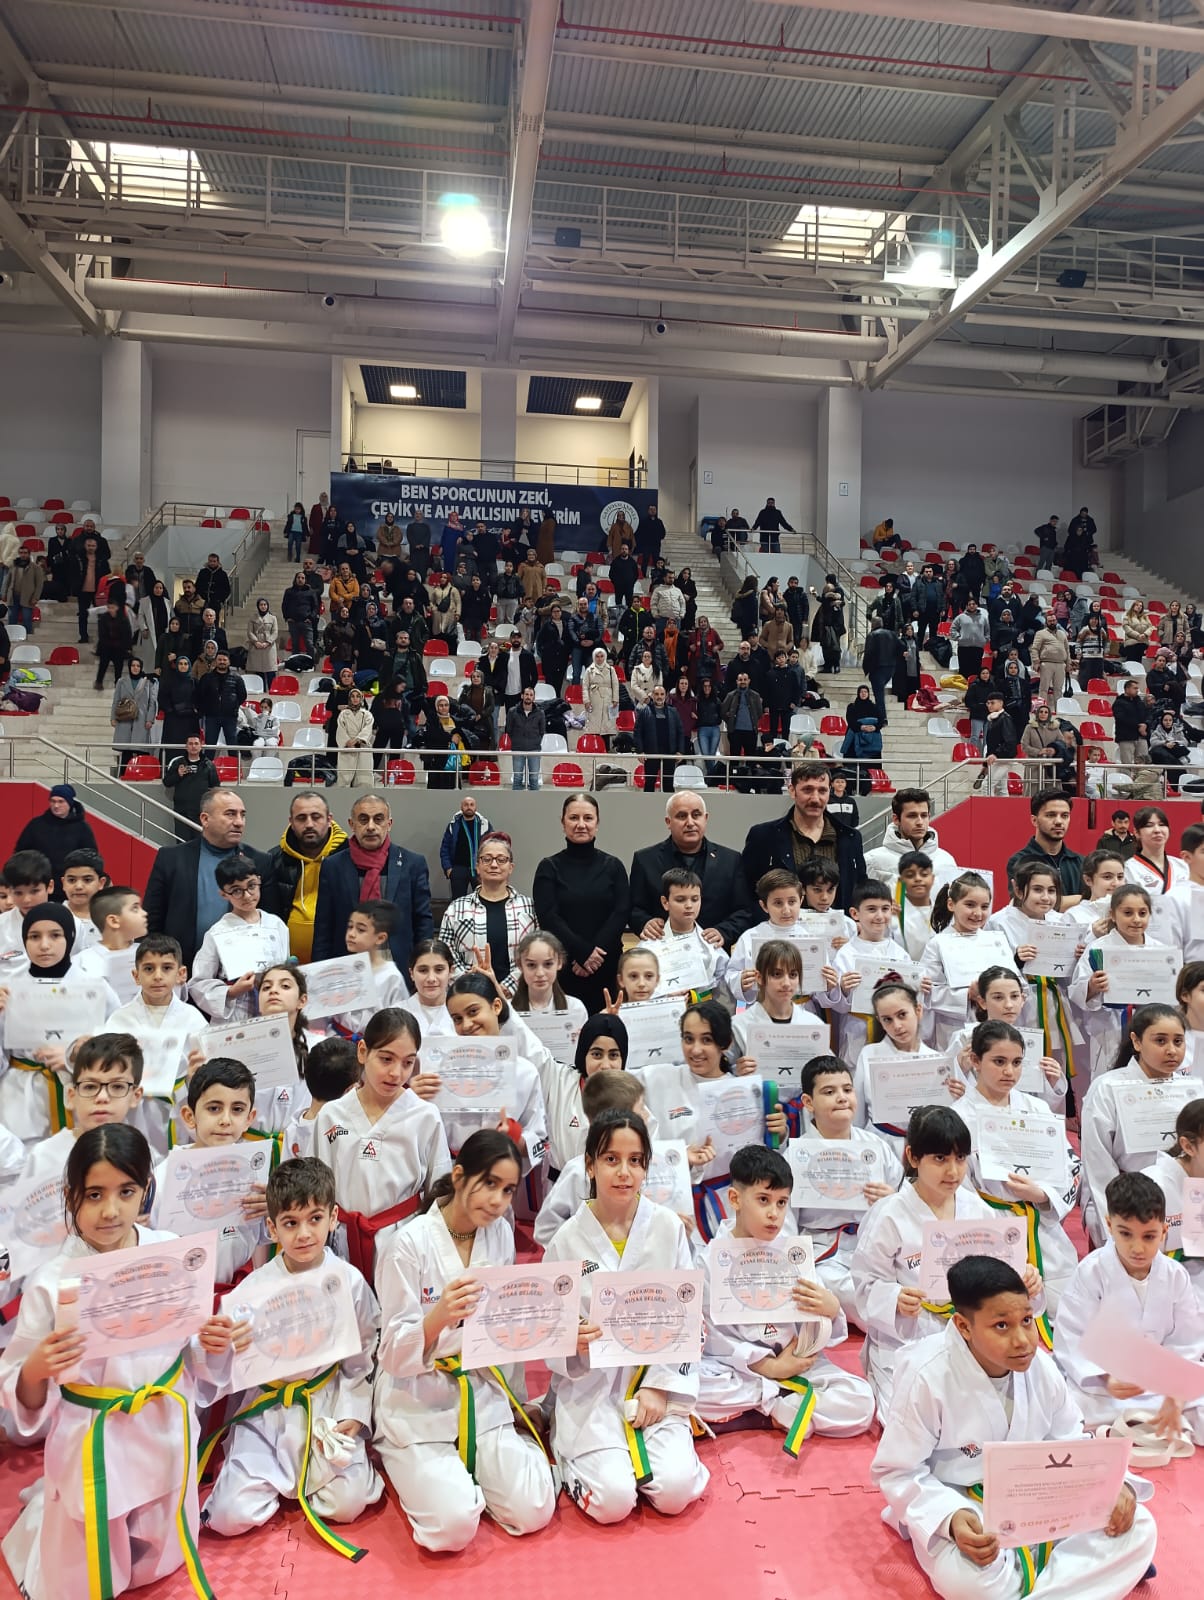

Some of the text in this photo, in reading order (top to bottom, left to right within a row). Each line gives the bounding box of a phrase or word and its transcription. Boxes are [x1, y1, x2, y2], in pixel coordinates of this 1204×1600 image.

[401, 484, 553, 508] BEN SPORCUNUN ZEKİ,
[371, 499, 413, 519] ÇEVİK
[414, 503, 432, 518] VE
